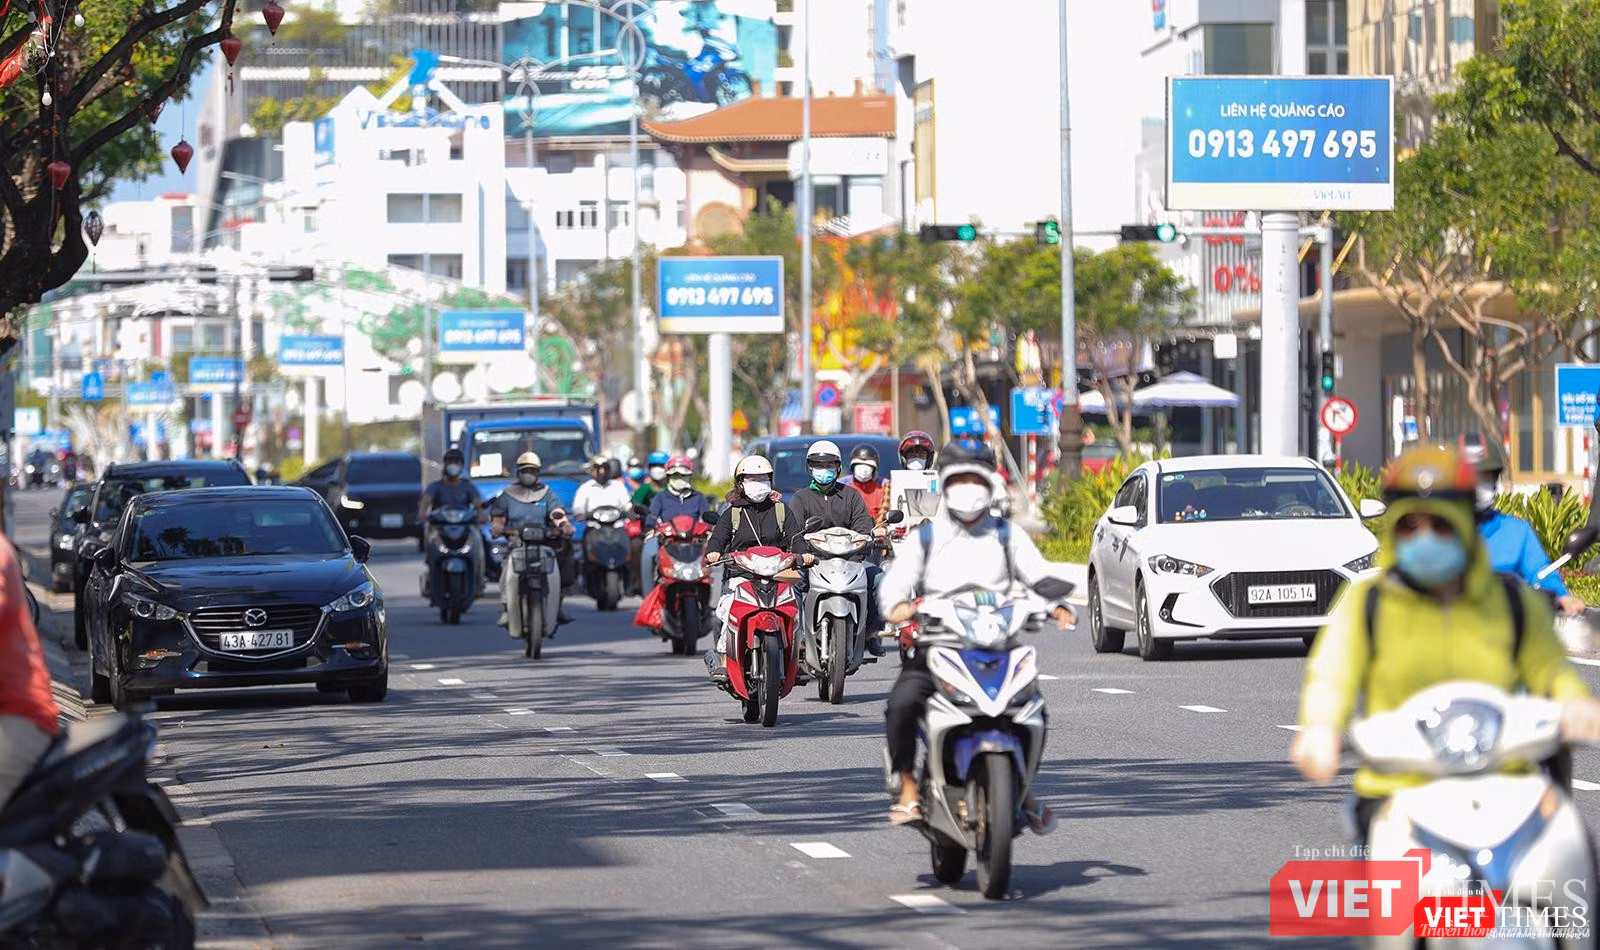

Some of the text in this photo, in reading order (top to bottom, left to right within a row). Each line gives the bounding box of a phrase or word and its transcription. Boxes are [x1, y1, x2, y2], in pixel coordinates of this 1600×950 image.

[1220, 102, 1346, 119] LIÊN HỆ QUẢNG CÁO
[1188, 129, 1377, 158] 0913 497 695
[667, 286, 706, 306] 0913
[741, 286, 774, 306] 695
